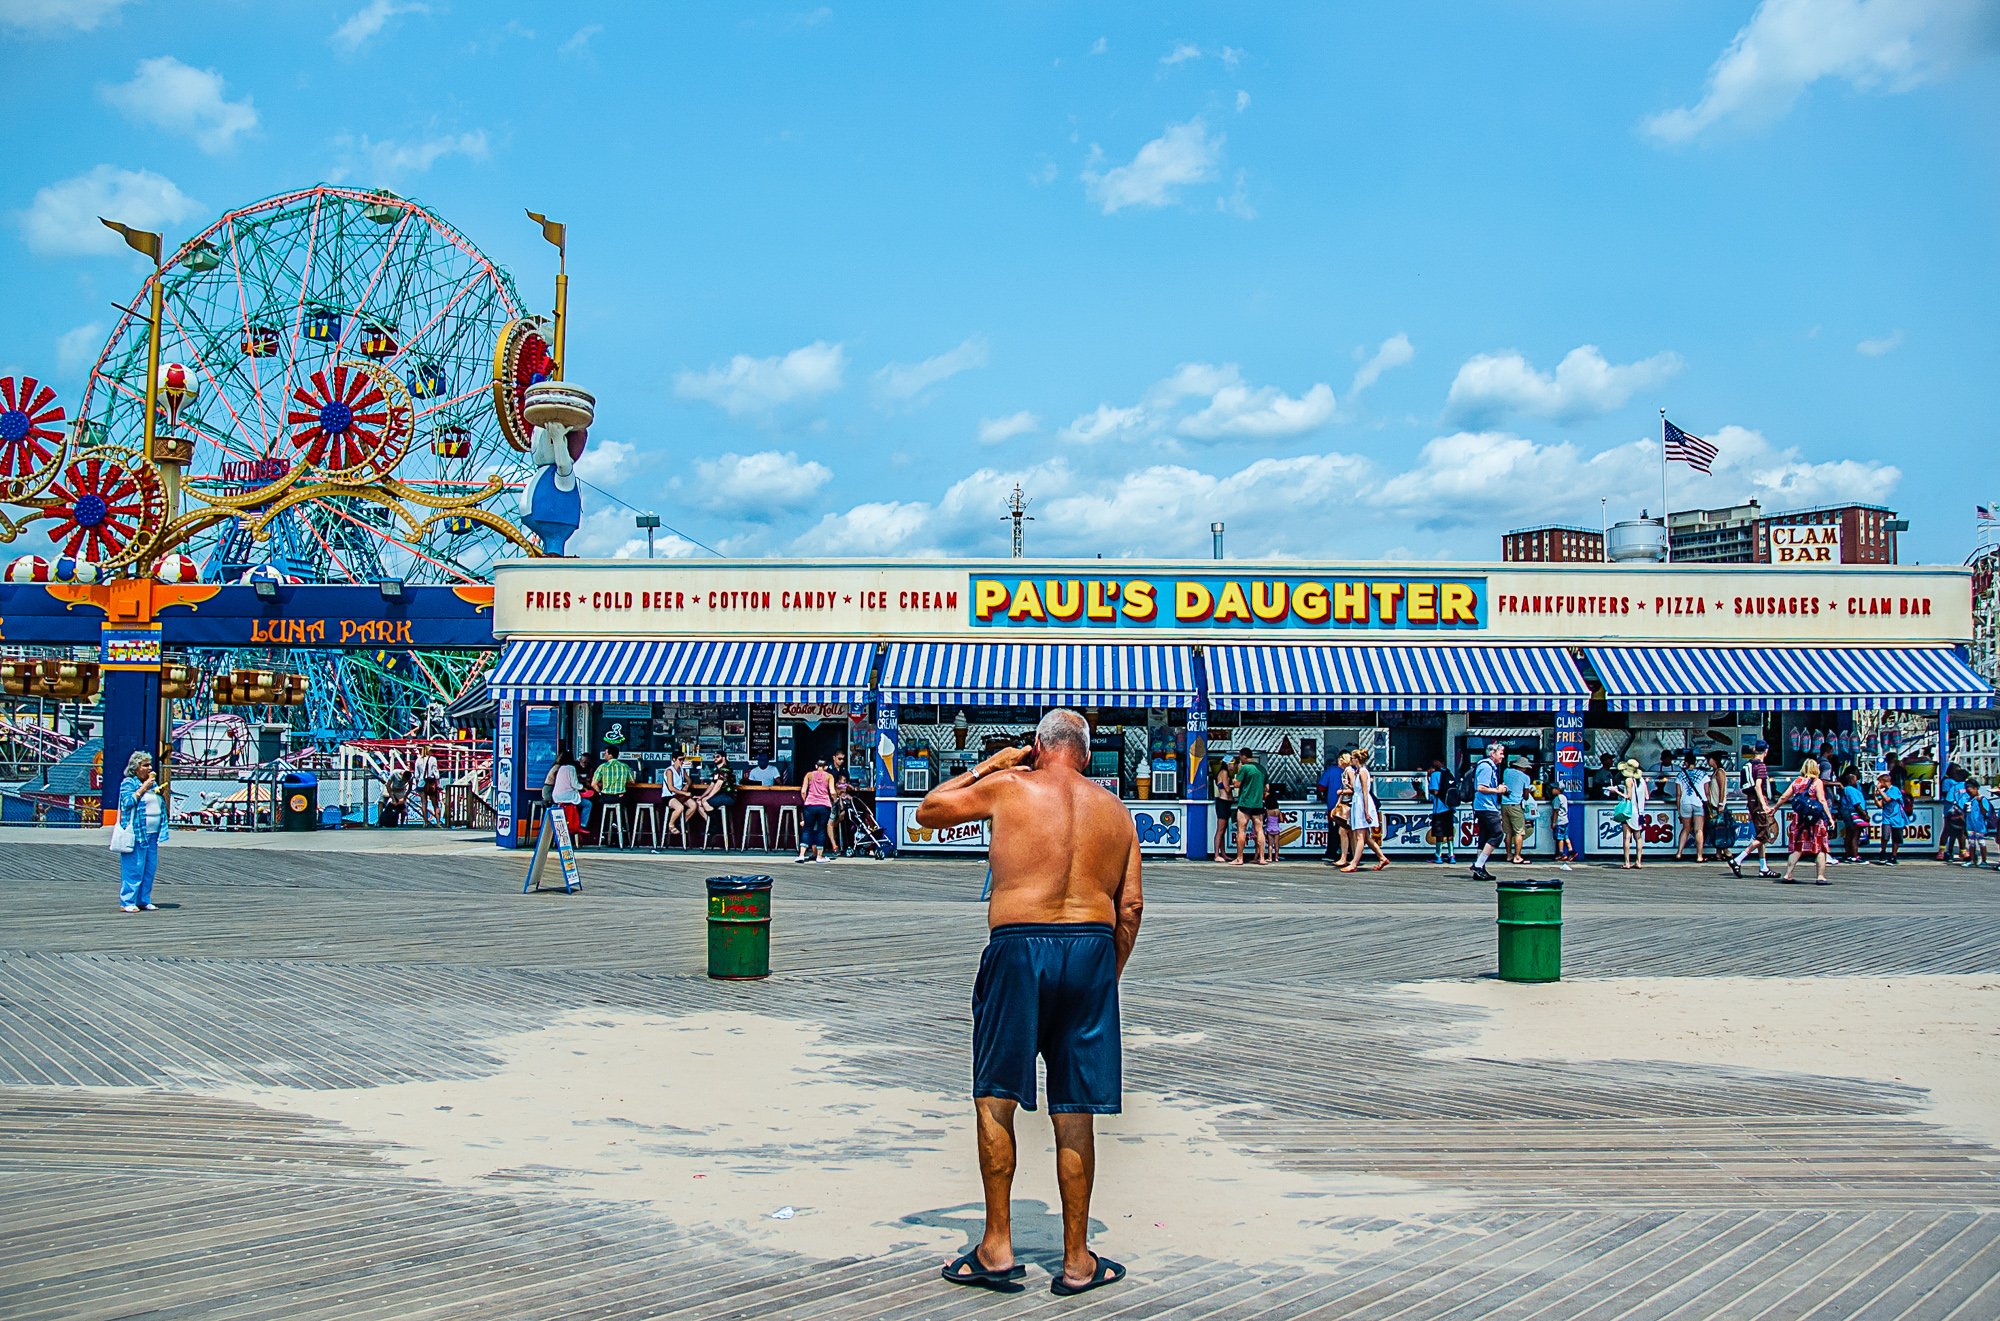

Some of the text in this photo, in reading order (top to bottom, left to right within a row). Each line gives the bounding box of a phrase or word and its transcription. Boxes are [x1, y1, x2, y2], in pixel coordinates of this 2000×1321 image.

[1772, 527, 1838, 545] CLAM
[1779, 547, 1831, 562] BAR
[526, 591, 957, 609] FRIES COLD BEER COTTON CANDY ICE CREAM
[975, 579, 1479, 625] PAUL'S DAUGHTER
[1498, 595, 1931, 615] FRANKFURTERS PIZZA SAUSAGES CLAM BAR
[250, 619, 414, 644] LUNA PARK
[782, 702, 817, 716] Lobster
[817, 702, 845, 718] Rolls
[878, 709, 896, 719] ICE
[1188, 711, 1207, 720] ICE
[877, 718, 898, 730] CREAM
[1186, 720, 1208, 732] CREAM
[1556, 716, 1583, 728] CLAMS
[1091, 736, 1108, 745] epsi
[1556, 731, 1583, 743] FRIES
[1556, 750, 1583, 763] PIZZA
[1306, 820, 1328, 830] Fren
[1903, 825, 1931, 840] ODAS
[937, 823, 982, 843] CREAM
[1306, 831, 1328, 846] FRI
